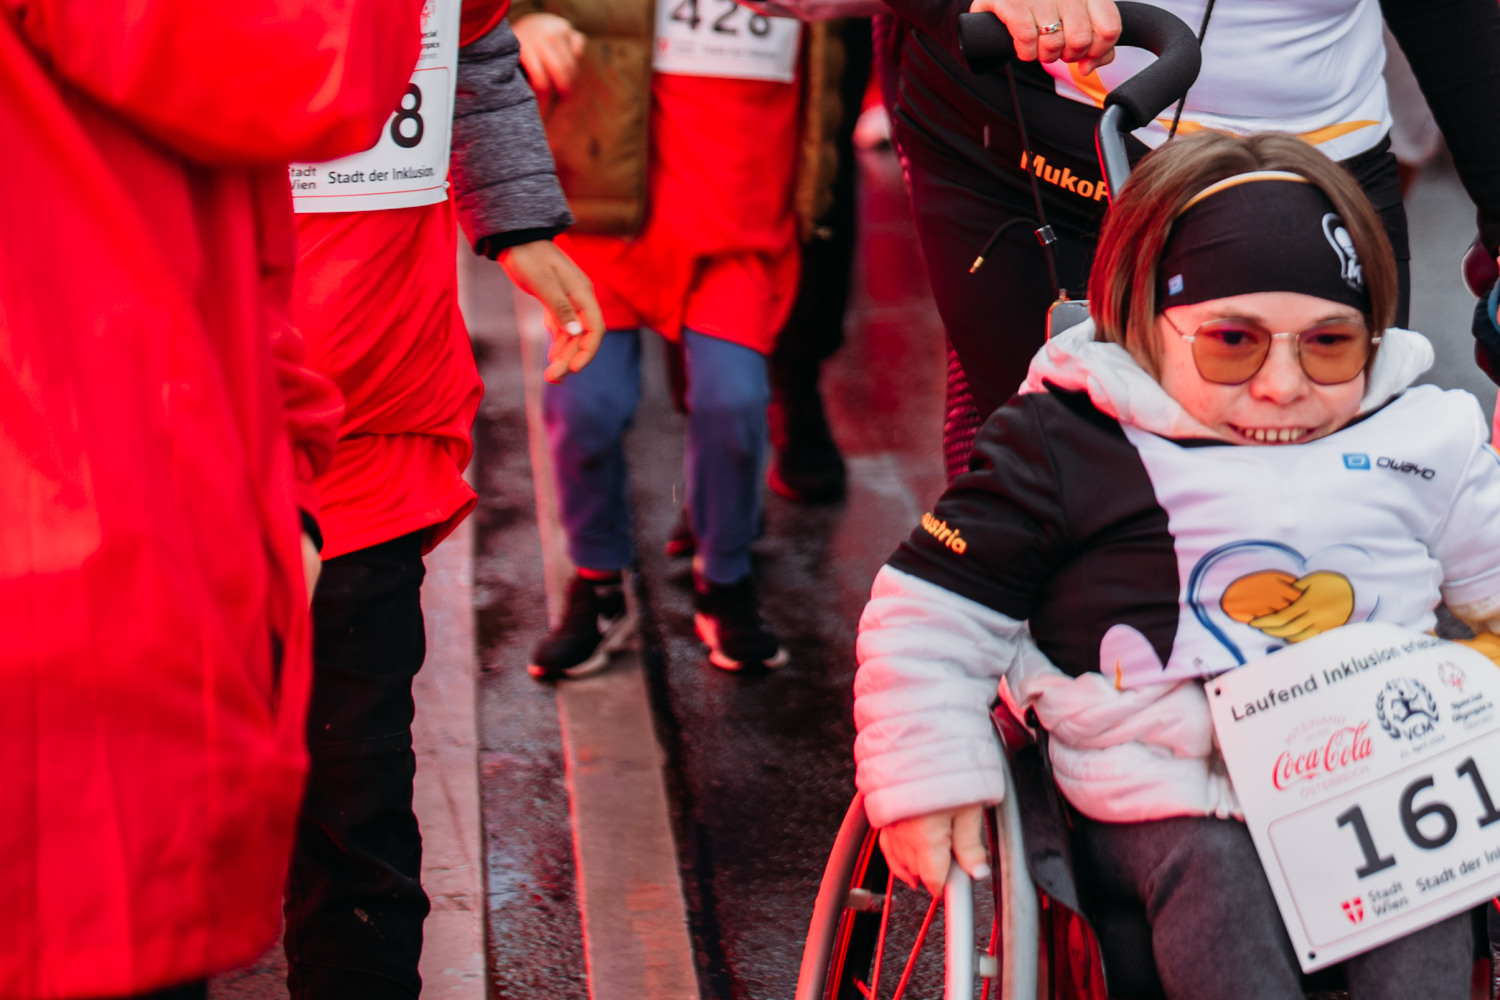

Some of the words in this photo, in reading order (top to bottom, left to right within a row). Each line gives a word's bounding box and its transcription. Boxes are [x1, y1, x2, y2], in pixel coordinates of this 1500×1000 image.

[289, 165, 317, 177] tadt
[328, 170, 366, 184] Stadt
[369, 169, 389, 182] der
[1376, 456, 1436, 481] owayo
[1231, 673, 1318, 722] Laufend
[1323, 646, 1401, 685] Inklusion
[1402, 720, 1435, 741] VCM
[1368, 880, 1404, 903] Stadt
[1416, 866, 1456, 893] Stadt
[1459, 857, 1482, 876] der
[1371, 896, 1409, 917] Wien
